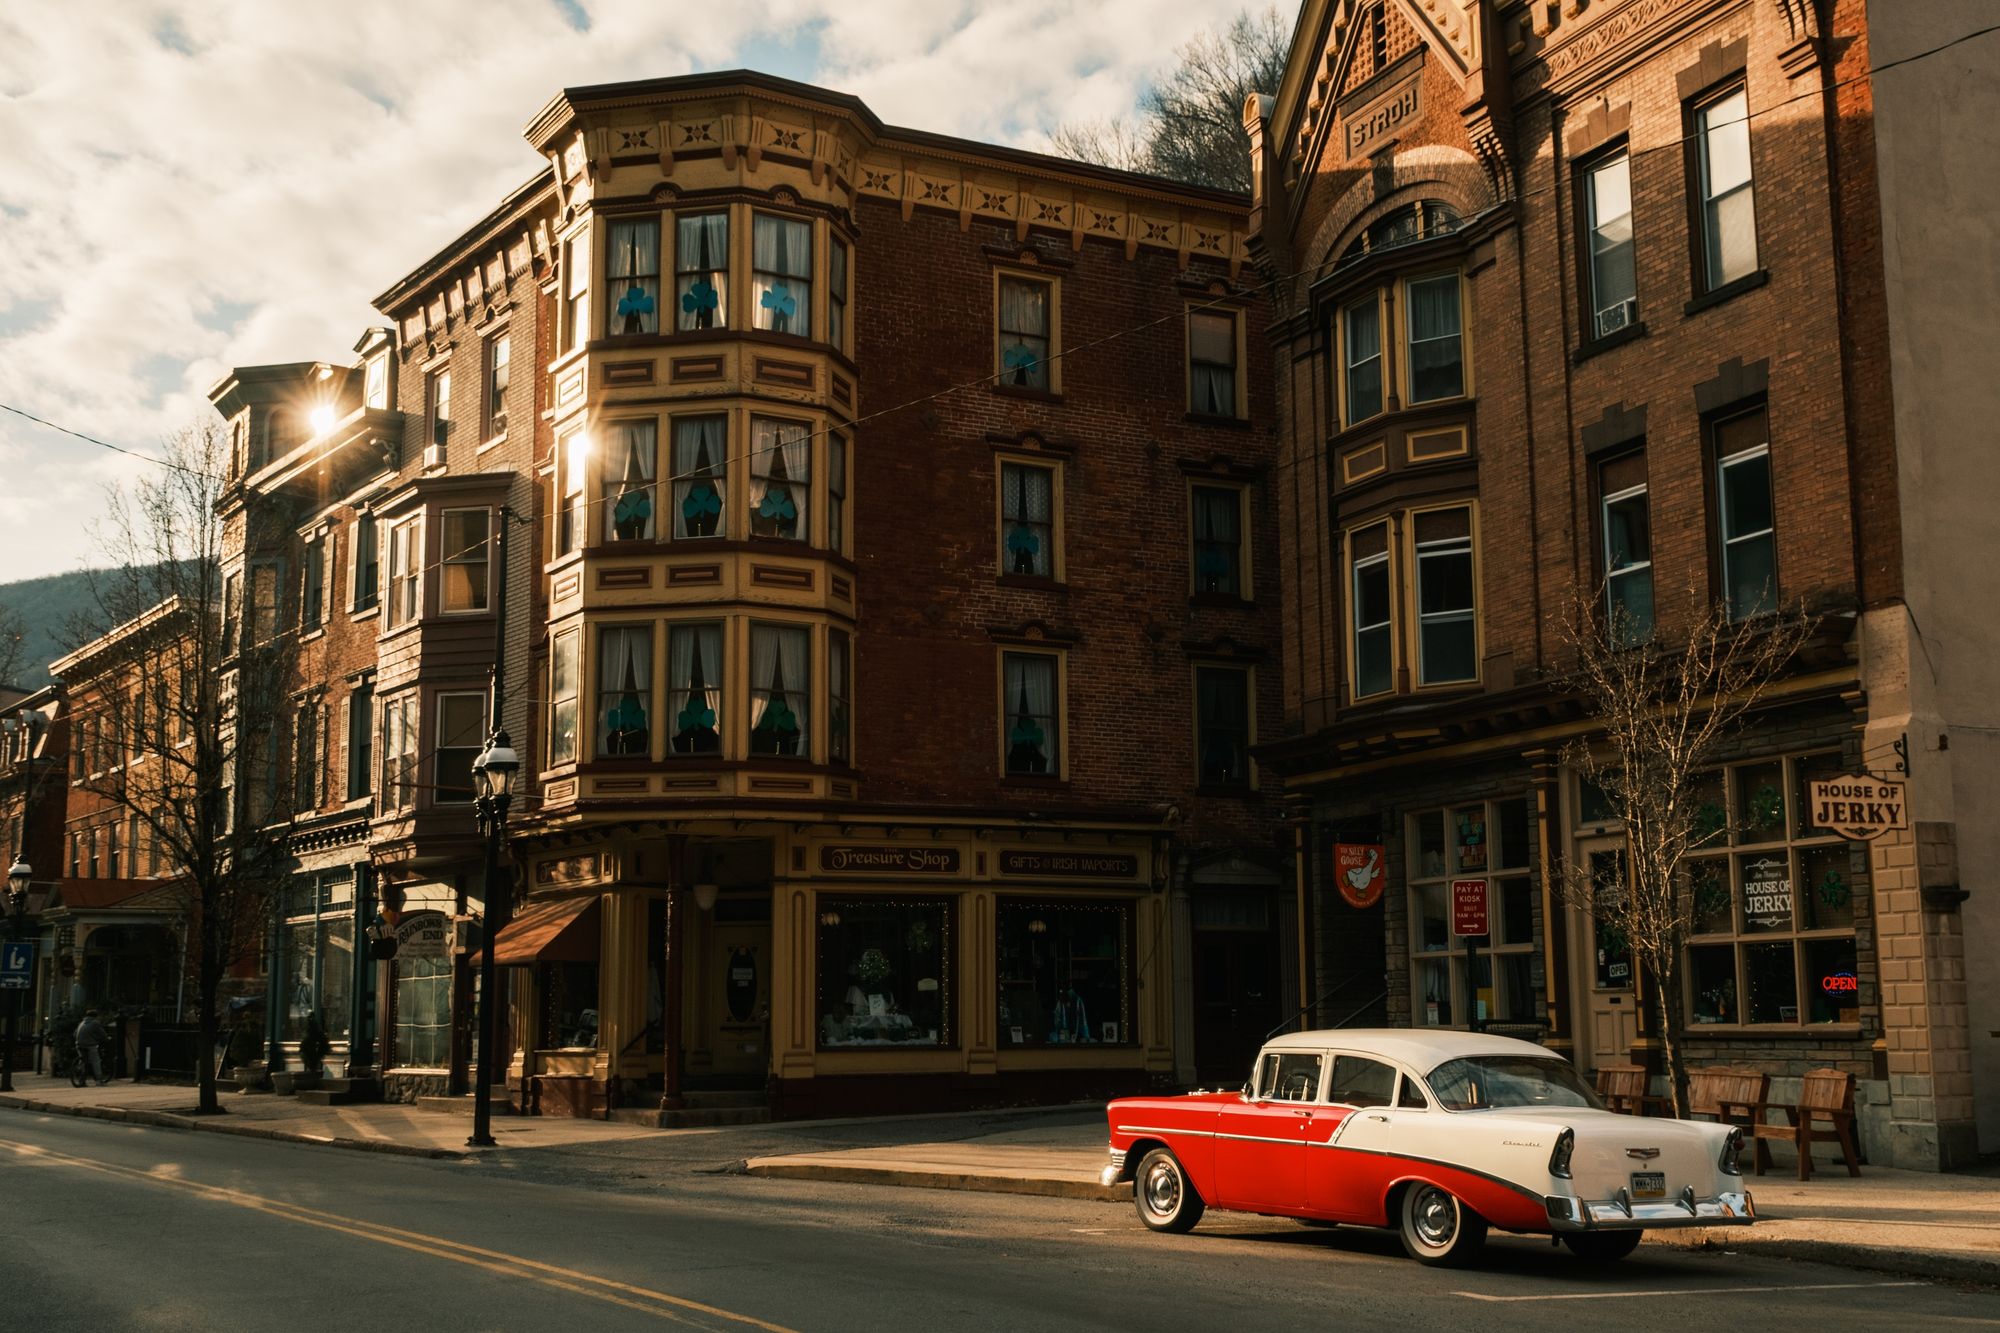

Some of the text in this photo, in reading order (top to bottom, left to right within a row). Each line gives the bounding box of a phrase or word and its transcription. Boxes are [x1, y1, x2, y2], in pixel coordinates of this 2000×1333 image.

[1353, 89, 1417, 148] STROH
[1817, 785, 1899, 799] HOUSE OF
[1817, 802, 1901, 824] JERKY
[1349, 847, 1364, 856] SILLY
[832, 848, 950, 871] Treasure Shop
[1009, 856, 1040, 869] GIFTS
[1052, 857, 1077, 870] IRISH
[1081, 858, 1128, 872] IMPORTS
[1340, 855, 1364, 866] GOOSE
[1745, 880, 1790, 894] HOUSE OF
[1459, 895, 1480, 903] KIOSK
[1745, 894, 1791, 914] JERKY
[1610, 965, 1627, 976] OPEN
[1822, 976, 1857, 991] OPEN
